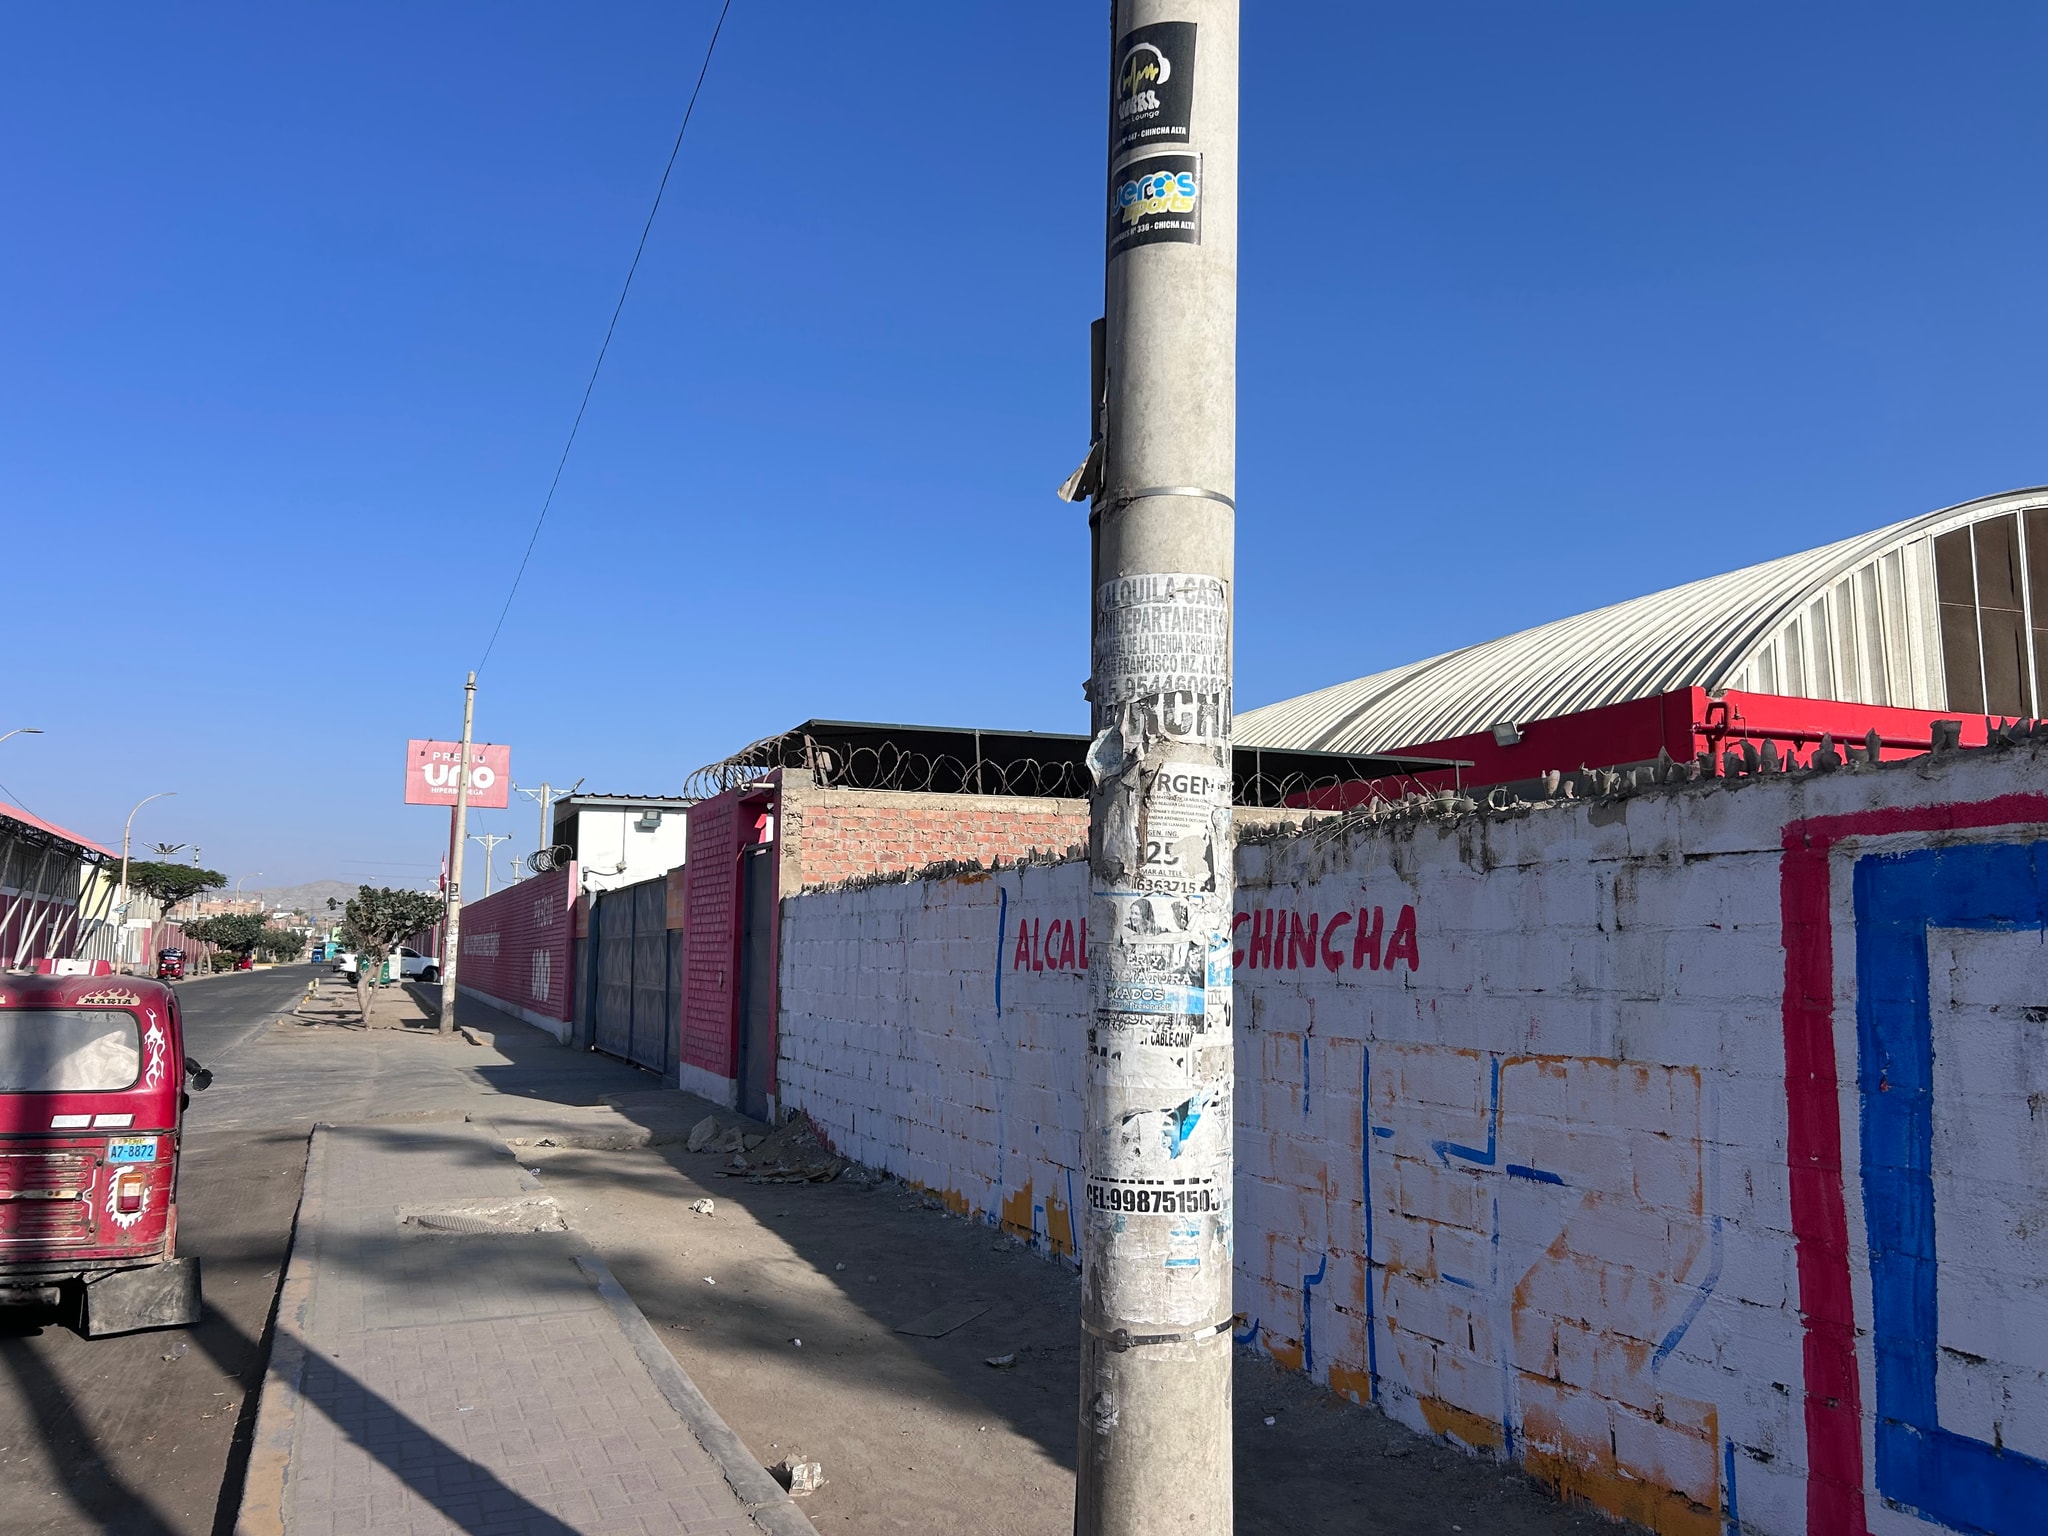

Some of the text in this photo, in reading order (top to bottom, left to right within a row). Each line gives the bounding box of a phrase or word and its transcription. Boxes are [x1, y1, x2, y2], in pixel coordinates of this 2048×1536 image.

[1132, 110, 1160, 122] Lounge
[1141, 126, 1170, 138] CHINCHA
[1170, 126, 1187, 135] ALTA
[1122, 193, 1196, 226] sports
[1154, 220, 1180, 230] CHICHA
[1180, 220, 1195, 230] ALTA
[1104, 576, 1178, 610] ALQUILA
[1140, 636, 1150, 655] LA
[1152, 634, 1184, 654] TIENDA
[1119, 654, 1178, 676] FRANCISCO
[433, 751, 486, 764] PREIO
[431, 787, 484, 796] HIPERBEGA
[1232, 904, 1420, 974] CHINCHA
[110, 1145, 154, 1159] A7-8872
